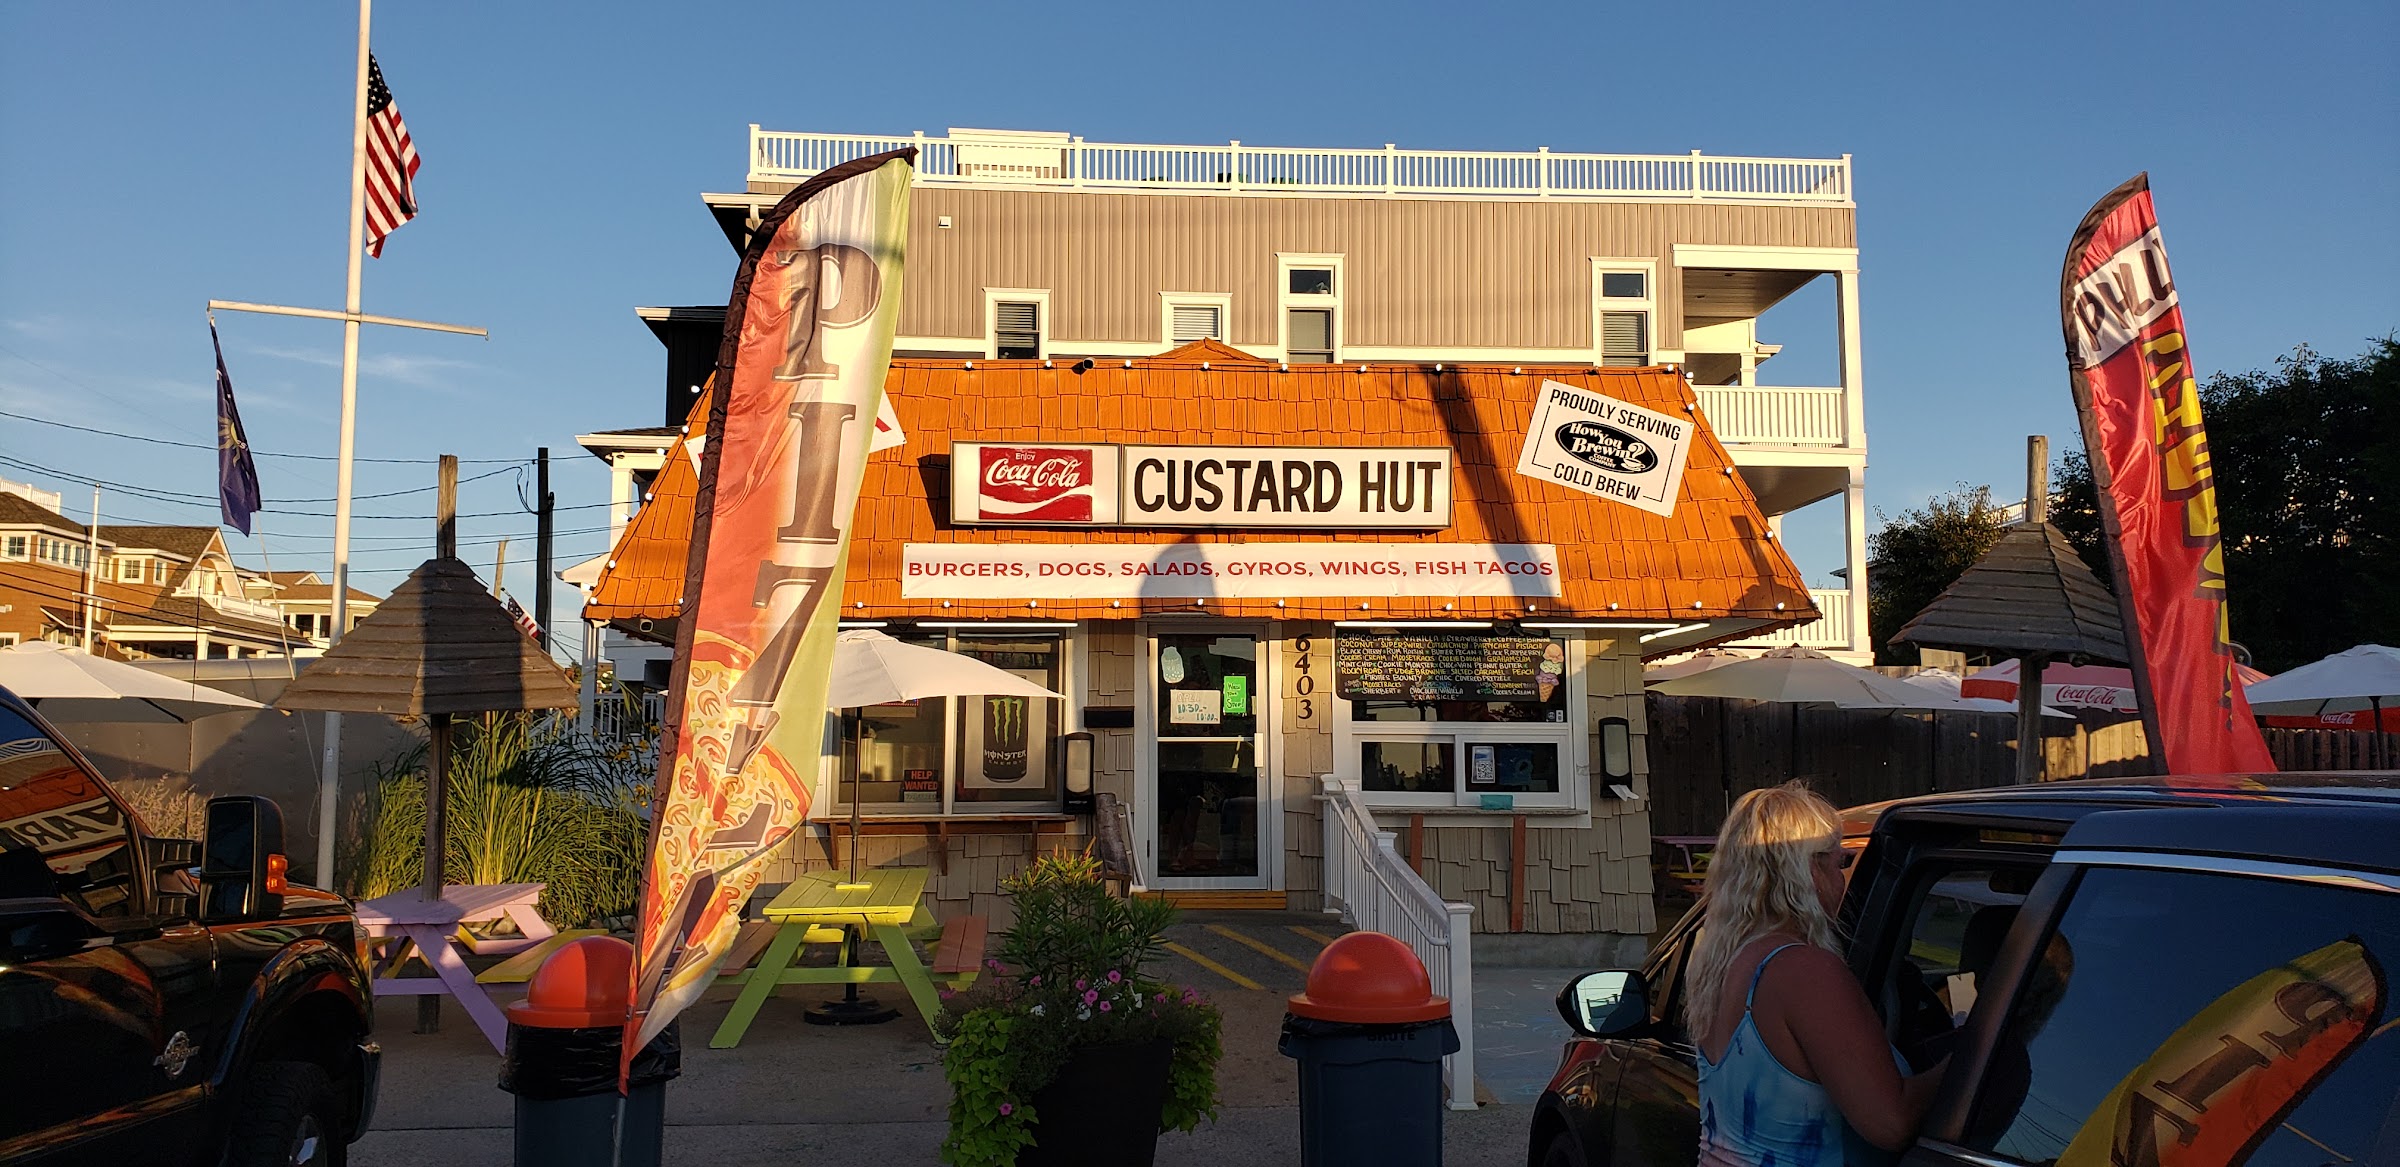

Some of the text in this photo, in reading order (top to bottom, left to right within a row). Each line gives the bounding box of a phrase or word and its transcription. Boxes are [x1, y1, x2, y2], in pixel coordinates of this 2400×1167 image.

[1549, 388, 1681, 441] PROUDLY SERVING
[1568, 422, 1602, 438] How
[1598, 433, 1623, 450] You
[1015, 452, 1035, 462] Enjoy
[1588, 456, 1617, 469] COMPANY
[1593, 453, 1614, 463] COFFEE
[985, 458, 1083, 488] Coca-Cola
[1134, 457, 1442, 513] CUSTARD HUT
[1553, 462, 1641, 501] COLD BREW
[908, 561, 1553, 579] BURGERS, DOGS, SALADS, GYROS, WINGS, FISH TACOS
[1341, 633, 1393, 642] CHOCOLATE
[1403, 632, 1440, 642] VANILLA
[1446, 634, 1492, 643] STRAWBERRY
[1340, 640, 1375, 649] COCONUT
[1340, 647, 1363, 655] BLACK
[1362, 648, 1383, 656] CHERRY
[1387, 648, 1402, 656] RUM
[1431, 648, 1455, 656] BUTTER
[1455, 648, 1478, 656] PECAN
[1483, 648, 1503, 656] BLACK
[1503, 648, 1542, 656] RASPBERRY
[1364, 654, 1388, 662] CREAM
[1338, 660, 1357, 668] MINT
[1376, 660, 1405, 669] COOKIE
[1404, 661, 1435, 669] MONSTER
[1295, 633, 1314, 720] 6403
[1341, 667, 1363, 675] ROCKY
[1363, 667, 1384, 675] ROAD
[1451, 668, 1473, 676] SALTED
[1473, 668, 1506, 676] CARAMEL
[1512, 668, 1536, 676] PEACH
[1392, 674, 1423, 682] BOUNTY
[1453, 674, 1483, 682] COVERED
[2056, 684, 2119, 705] Coca-Cola
[2321, 712, 2357, 725] Coca-Cola
[984, 749, 1027, 761] MONSTER
[911, 770, 933, 780] HELP
[904, 781, 938, 791] WANTED
